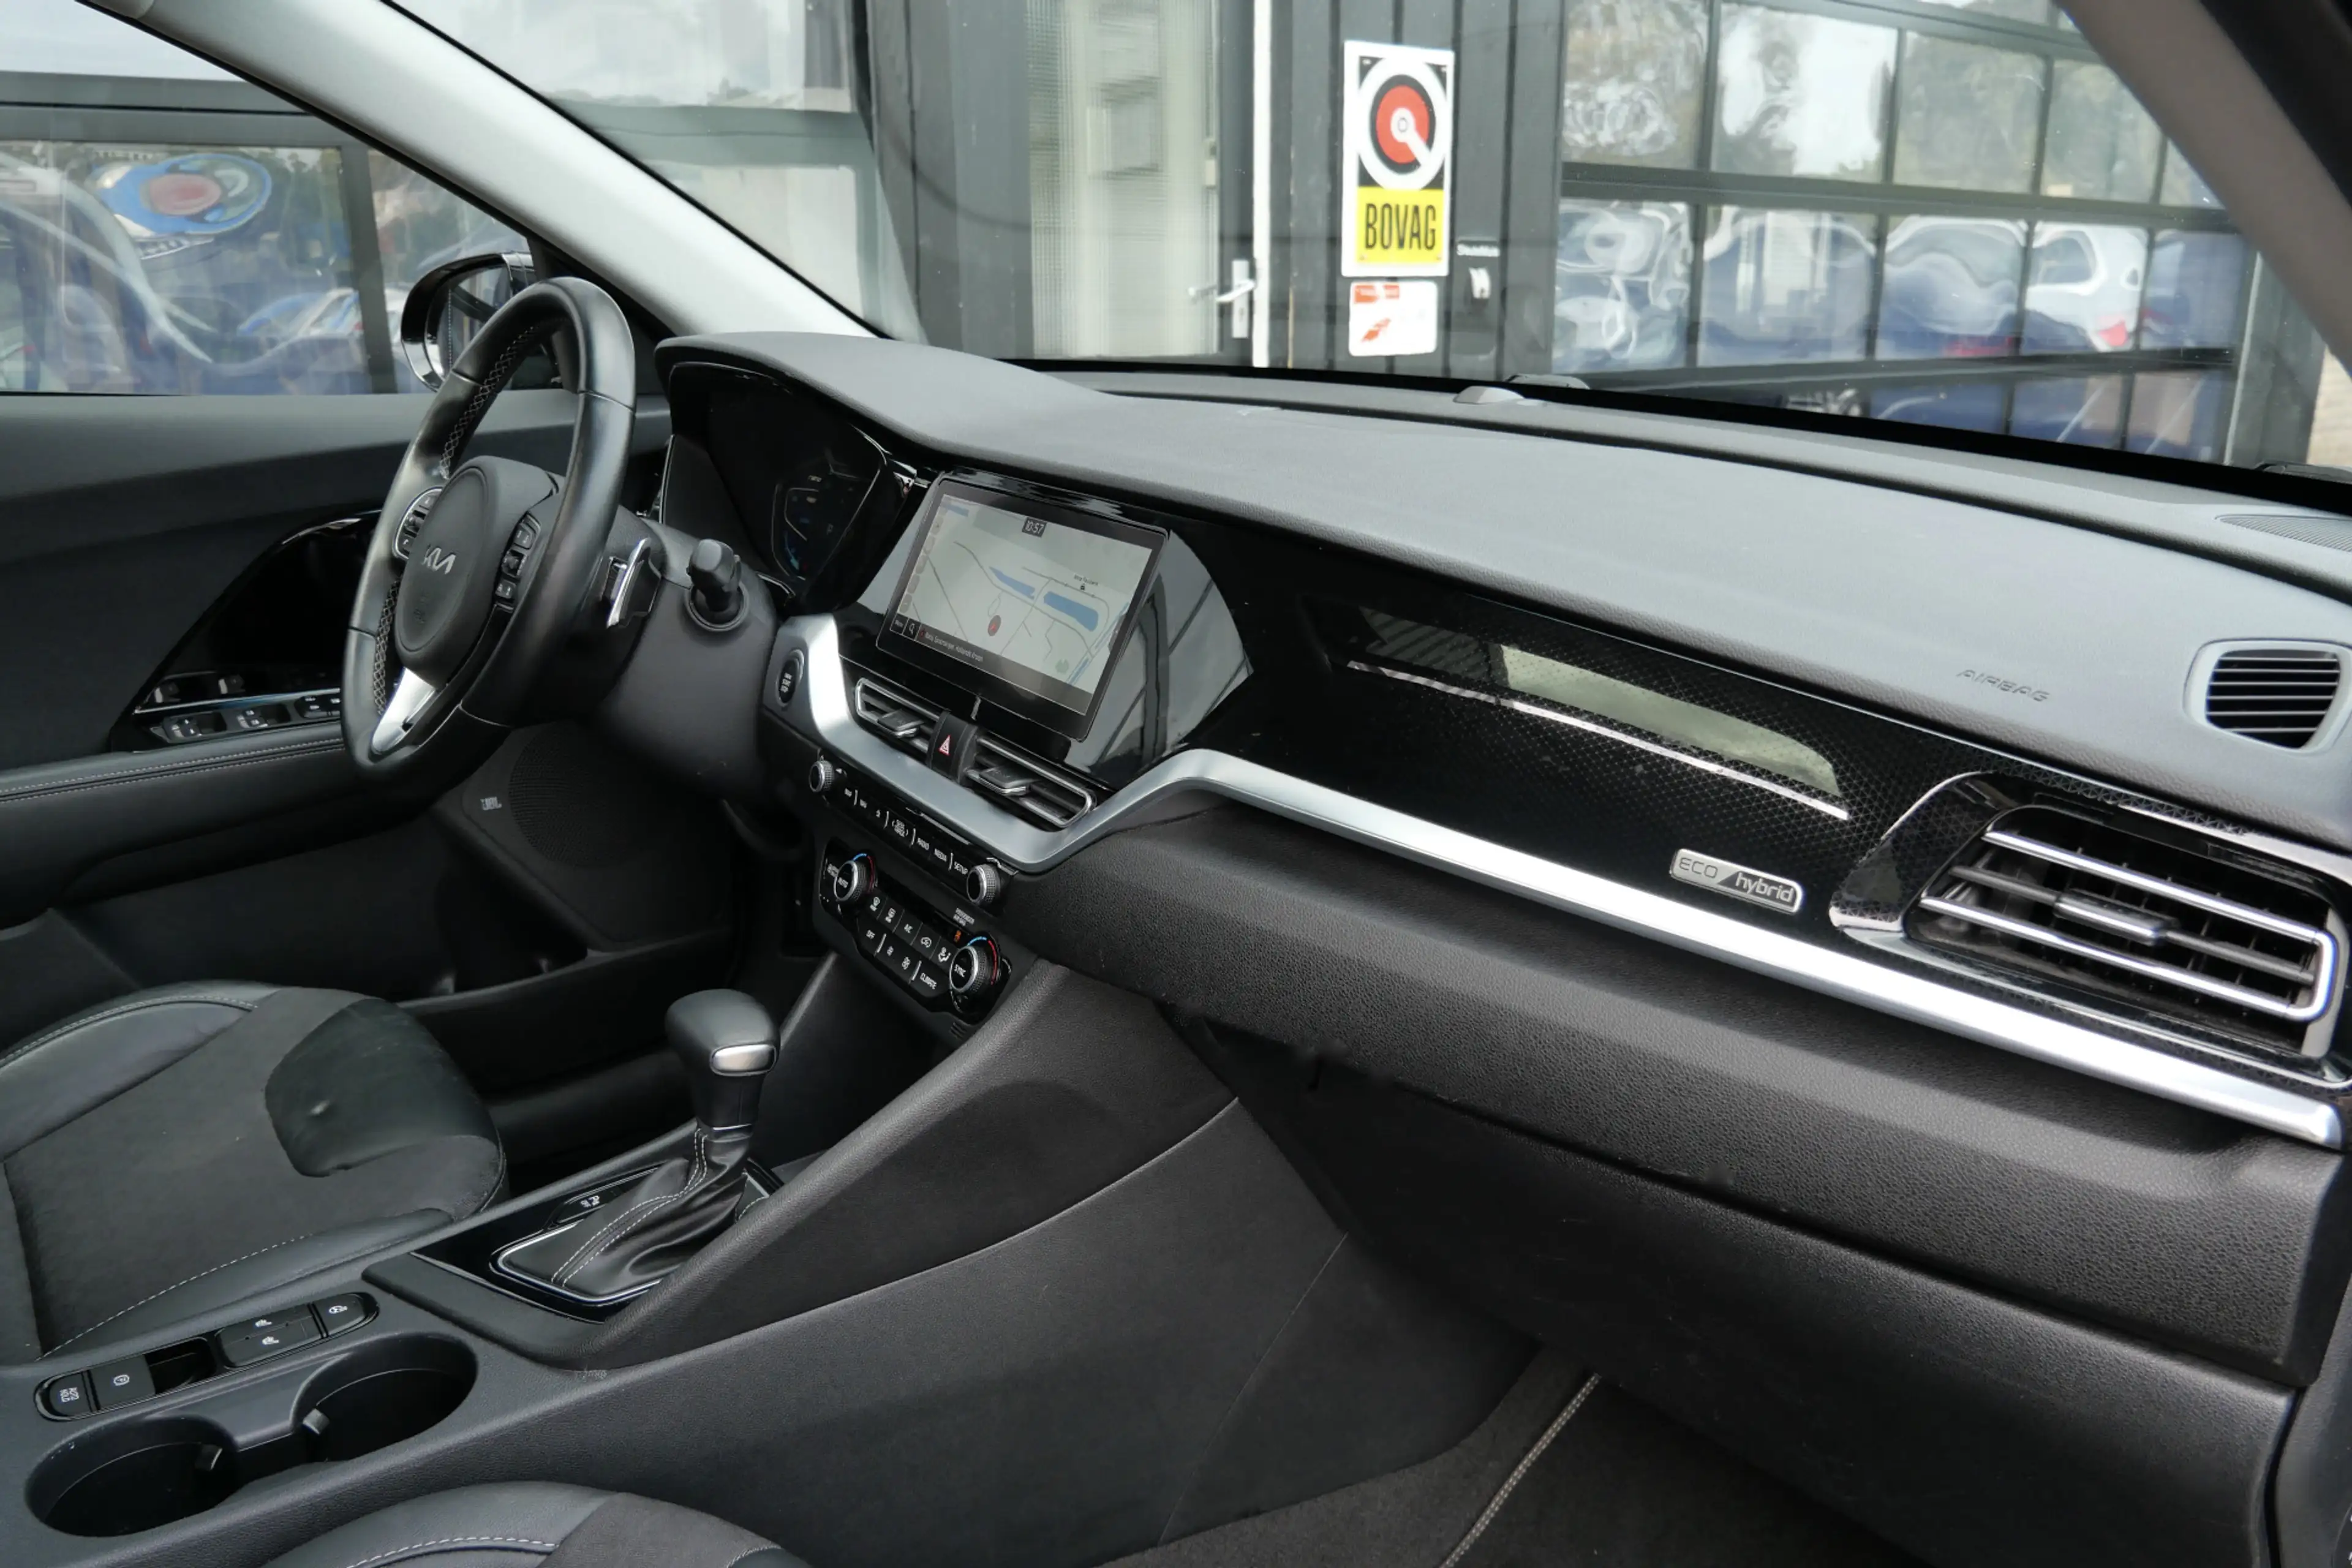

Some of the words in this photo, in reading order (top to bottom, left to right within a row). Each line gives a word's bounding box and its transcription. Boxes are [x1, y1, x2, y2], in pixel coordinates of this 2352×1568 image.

[1365, 202, 1437, 251] BOVAG
[1956, 669, 2050, 702] AIRBAG
[954, 861, 968, 875] SETUP
[1678, 857, 1719, 879] ECO
[1735, 872, 1795, 903] hybrid
